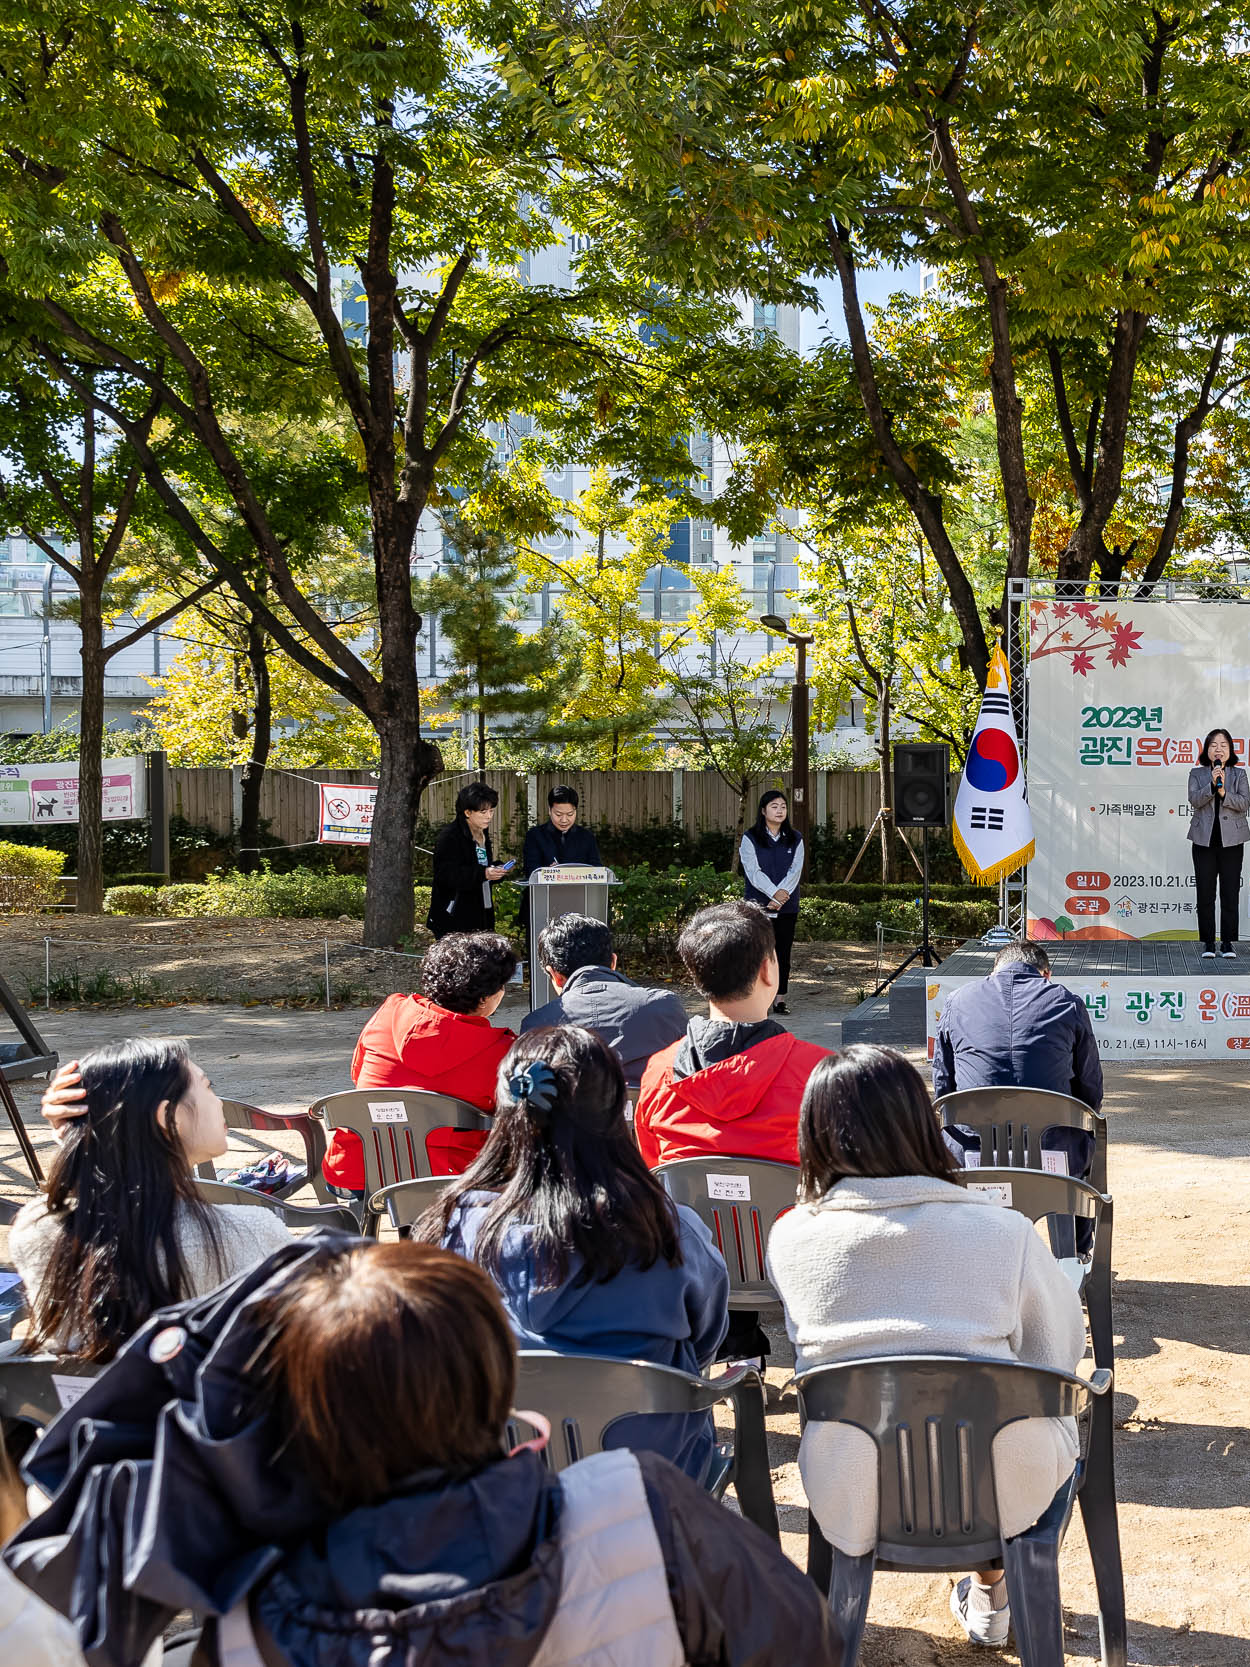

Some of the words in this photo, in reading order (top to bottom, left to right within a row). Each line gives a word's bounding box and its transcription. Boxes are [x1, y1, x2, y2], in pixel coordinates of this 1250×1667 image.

[1082, 706, 1163, 732] 2023년
[1079, 736, 1132, 765] 광진
[1099, 803, 1157, 817] 가족백일장
[1126, 991, 1183, 1022] 광진
